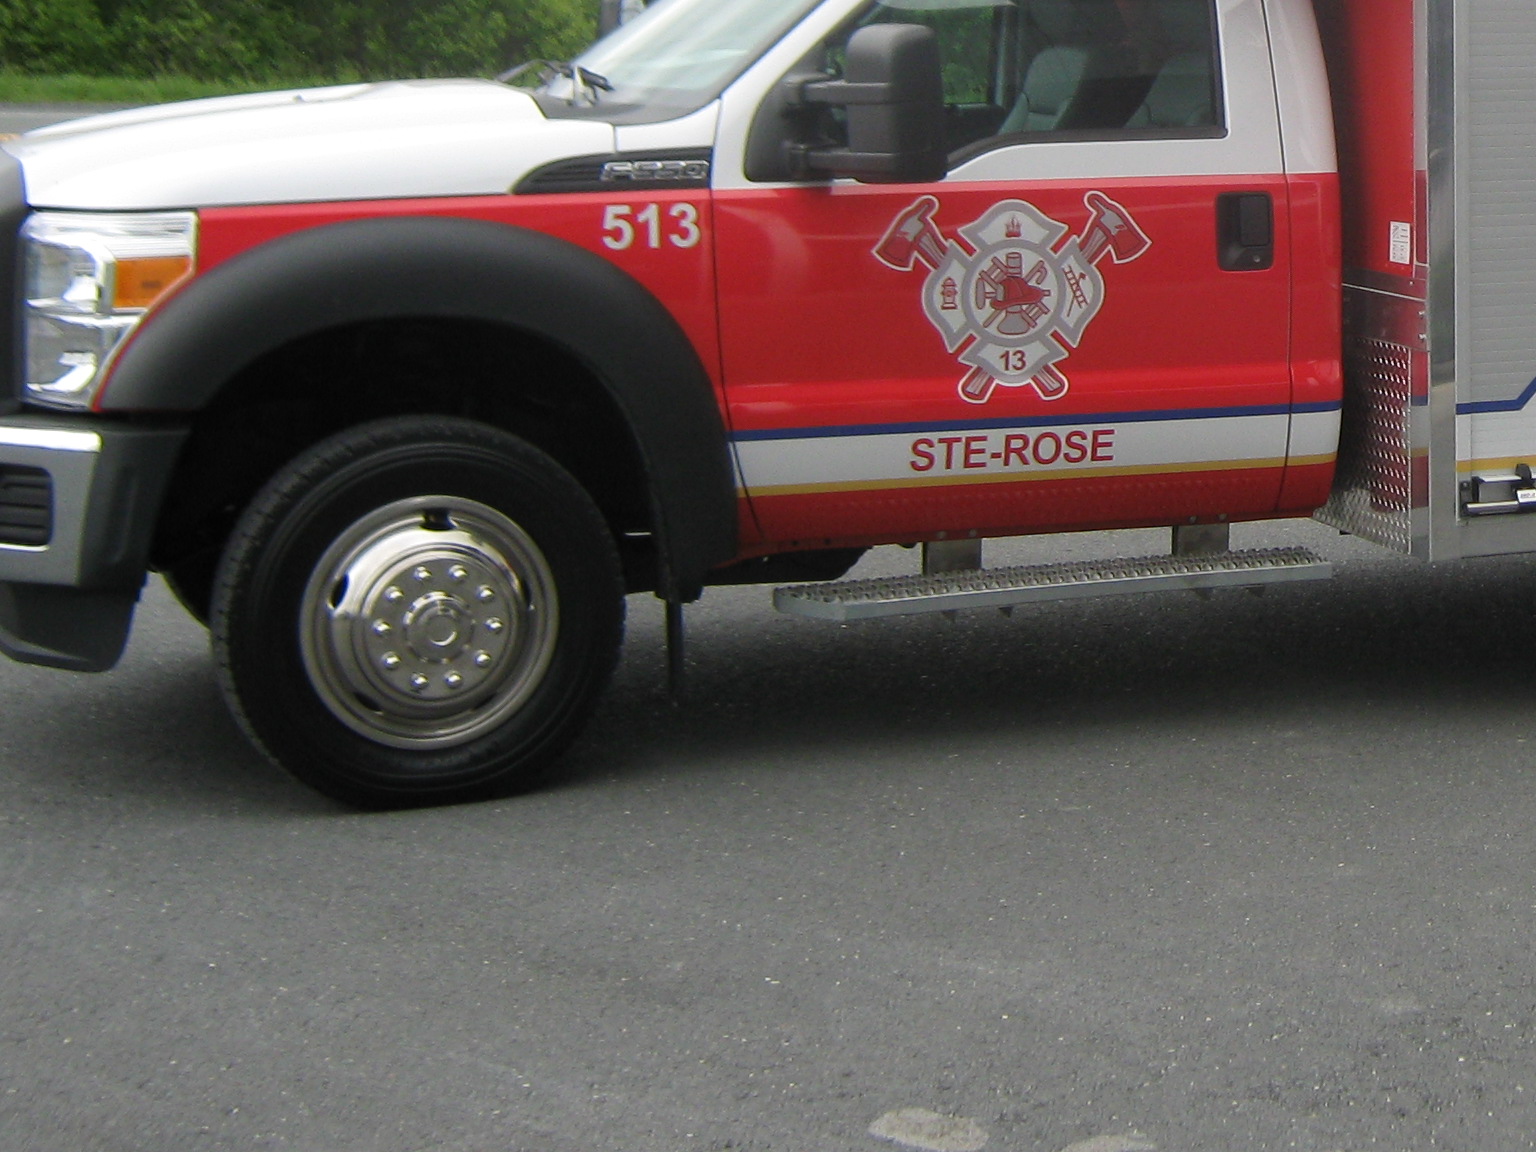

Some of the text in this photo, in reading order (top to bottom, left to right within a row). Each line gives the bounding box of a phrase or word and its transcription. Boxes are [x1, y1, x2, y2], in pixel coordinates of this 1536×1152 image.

[601, 202, 702, 251] 513
[999, 349, 1027, 372] 13
[909, 428, 1116, 472] STE-ROSE
